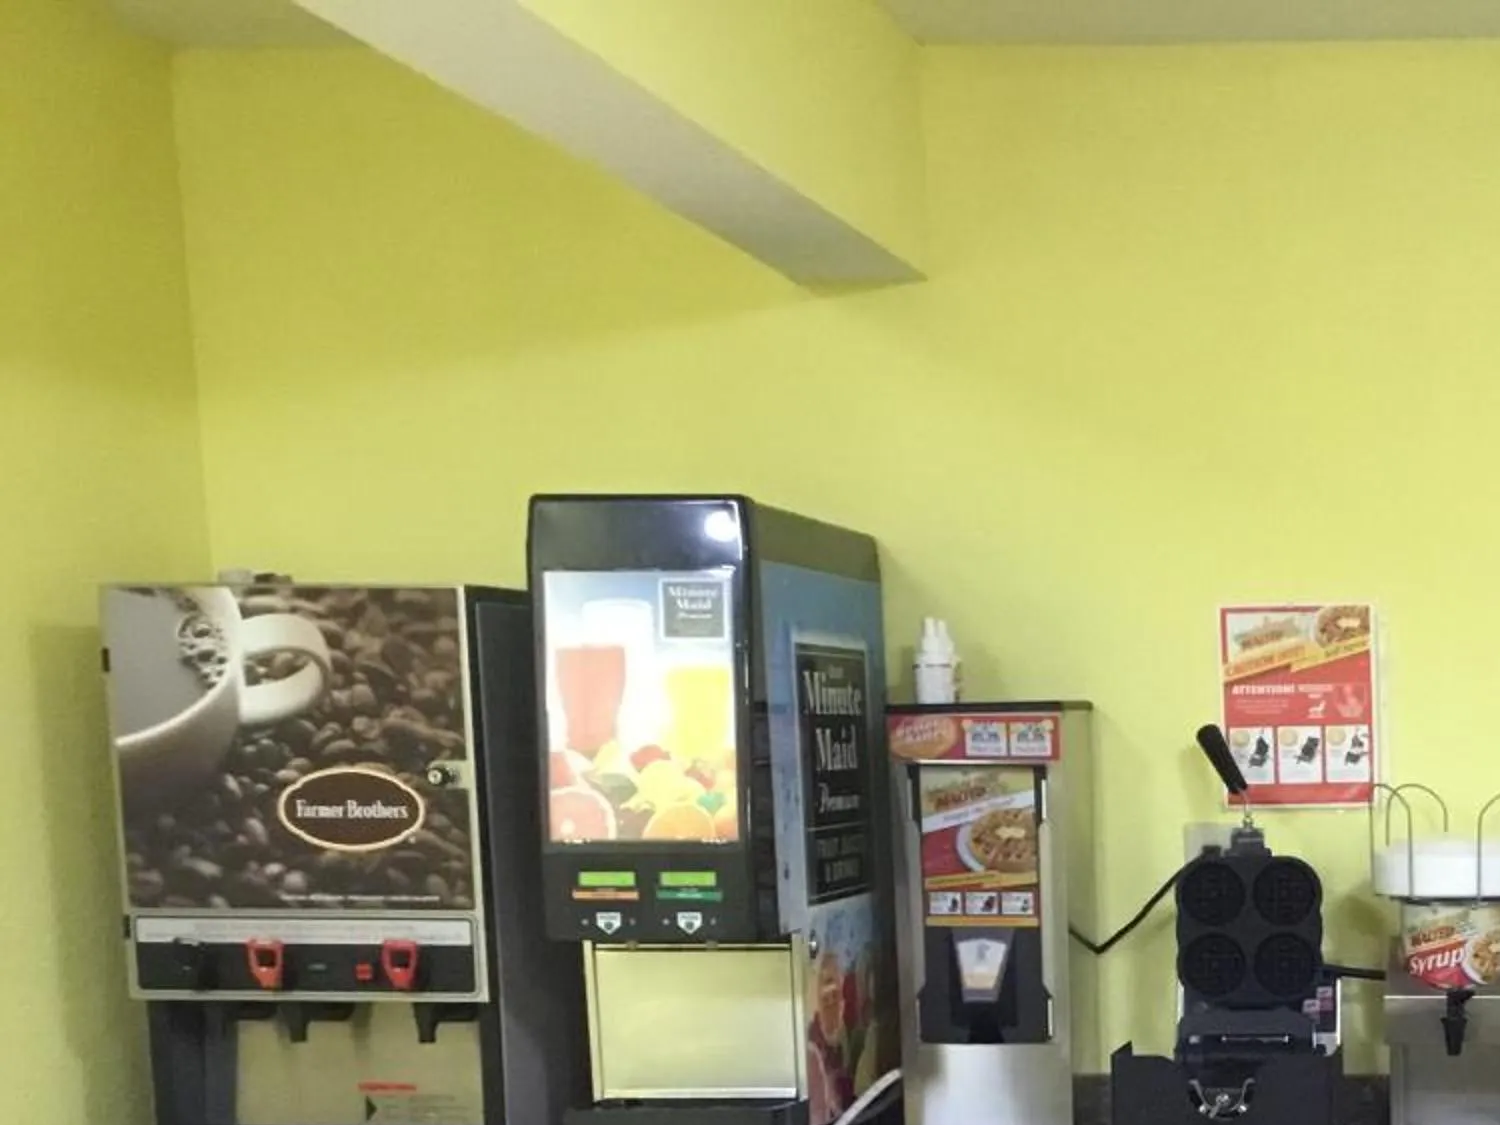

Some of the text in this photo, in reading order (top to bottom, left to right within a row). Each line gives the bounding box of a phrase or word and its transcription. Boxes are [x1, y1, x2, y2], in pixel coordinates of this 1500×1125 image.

[803, 671, 862, 716] Minute
[816, 724, 858, 771] Maid
[295, 799, 409, 819] Farmer Brothers
[1409, 947, 1466, 977] Syrup
